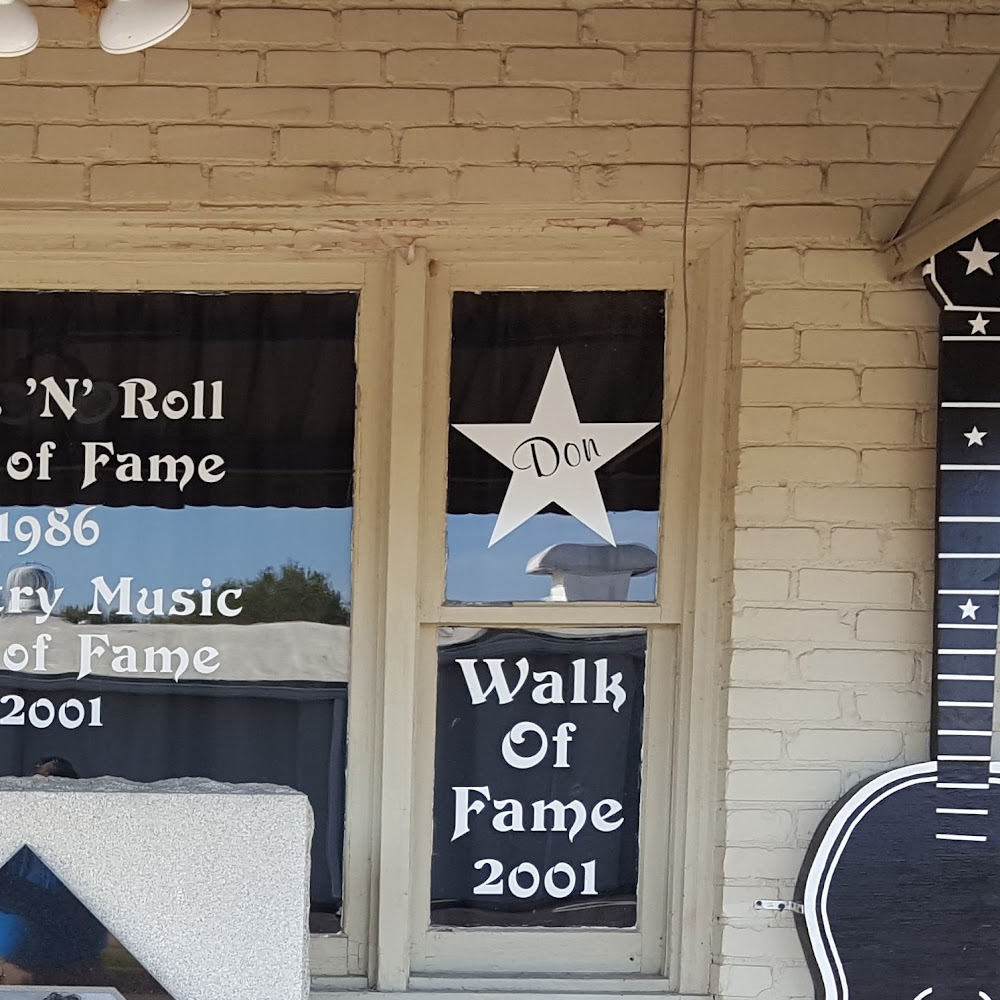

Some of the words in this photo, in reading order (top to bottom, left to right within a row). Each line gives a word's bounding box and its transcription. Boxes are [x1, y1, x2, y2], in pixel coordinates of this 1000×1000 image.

[119, 377, 225, 421] Roll
[6, 441, 56, 481] of
[81, 441, 227, 492] Fame
[512, 432, 602, 480] Don
[89, 576, 243, 618] Music
[3, 634, 52, 673] of
[77, 633, 221, 683] Fame
[455, 657, 628, 713] Walk
[0, 695, 104, 728] 2001
[501, 720, 578, 770] Of
[450, 786, 625, 842] Fame
[472, 858, 599, 899] 2001
